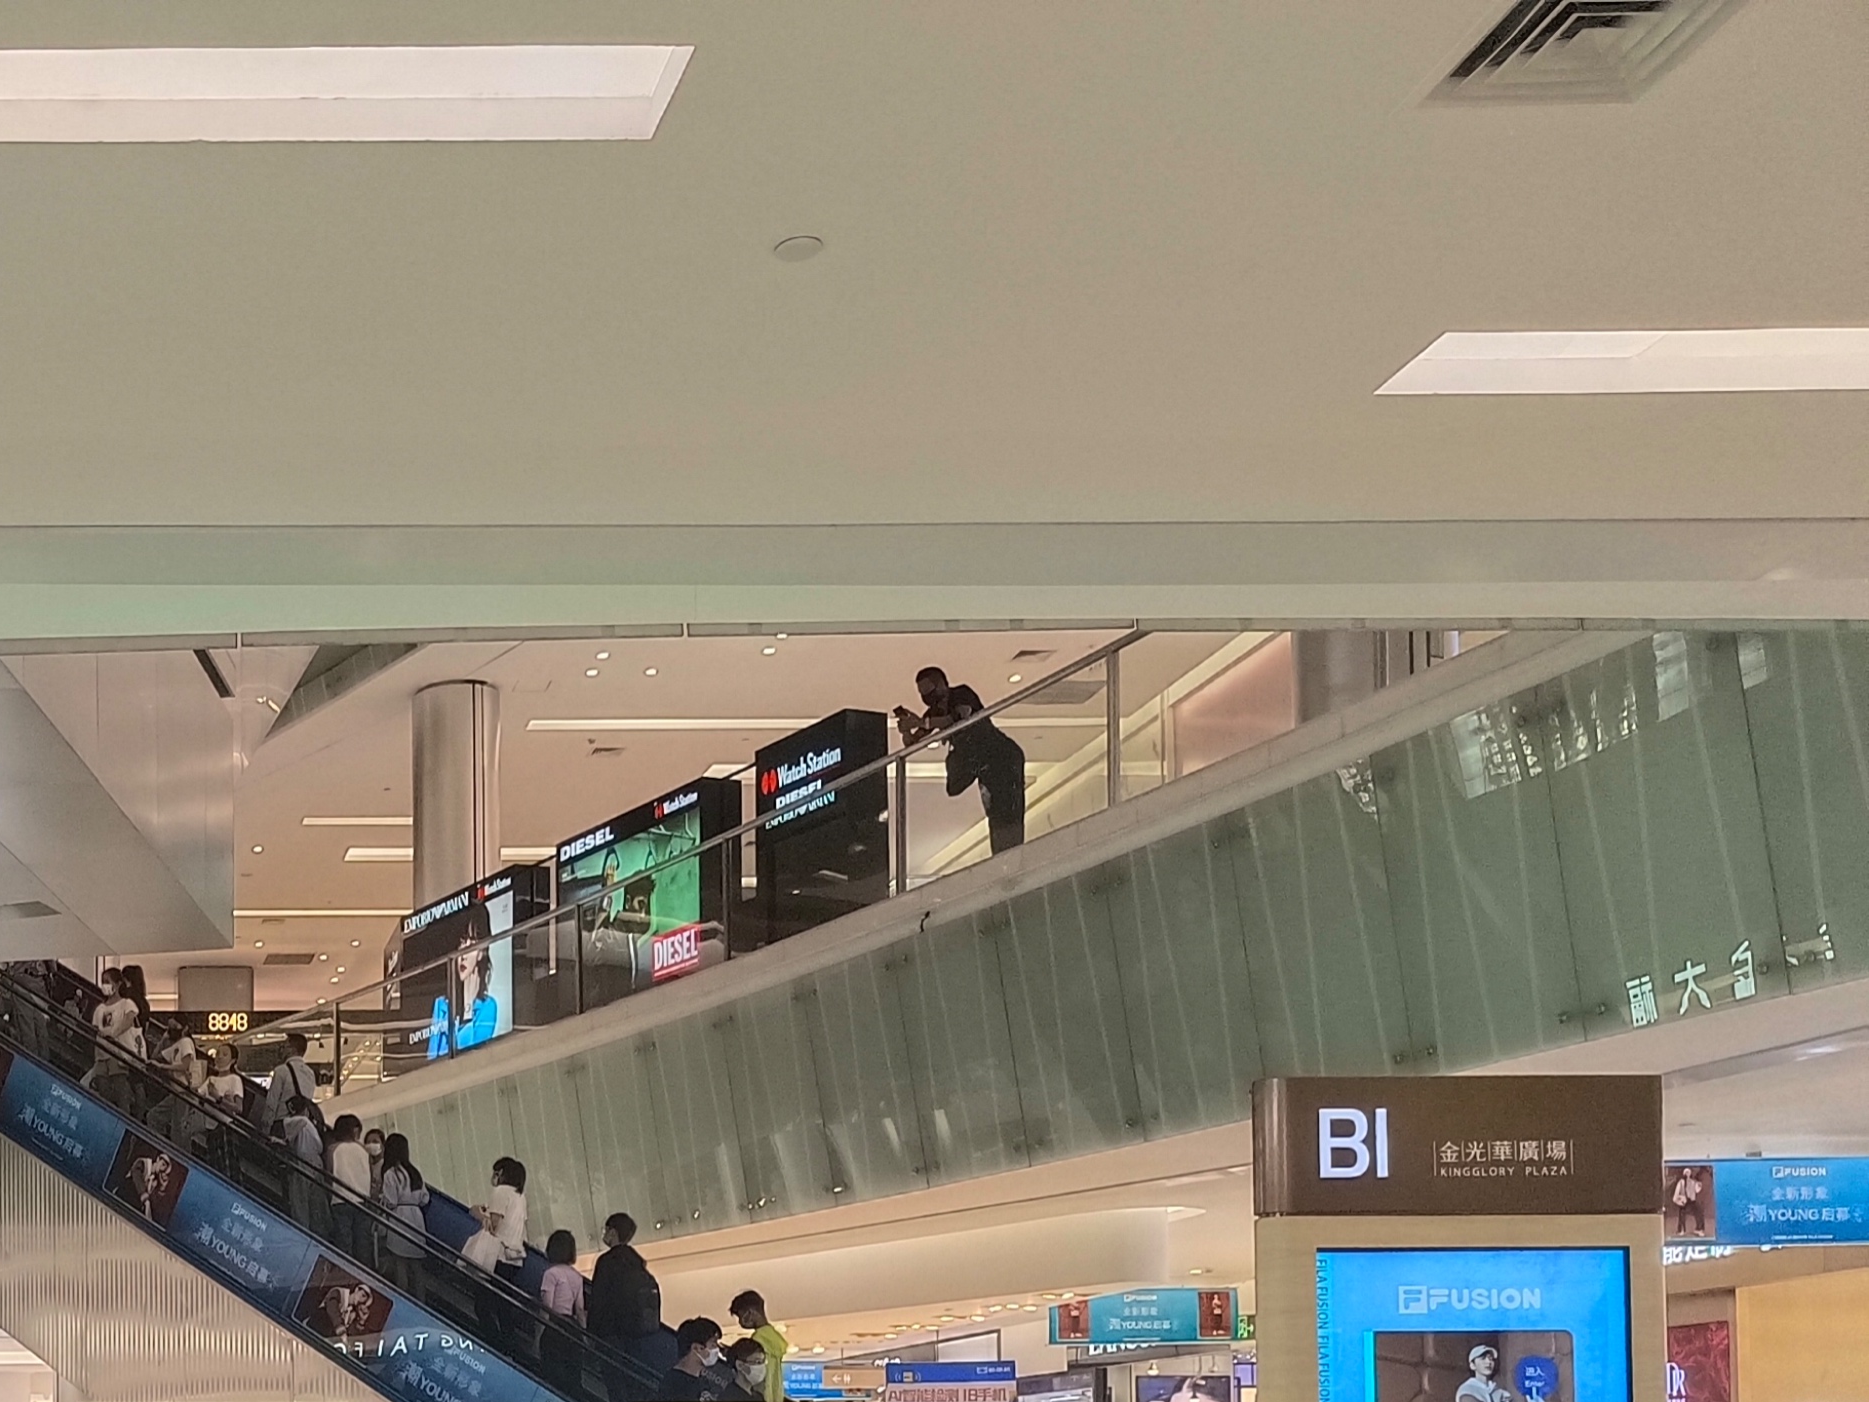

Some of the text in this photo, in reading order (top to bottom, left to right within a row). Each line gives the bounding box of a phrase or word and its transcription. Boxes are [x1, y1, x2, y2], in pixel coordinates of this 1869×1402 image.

[777, 747, 842, 789] Watch Station
[560, 826, 614, 862] DIESEL
[654, 928, 699, 970] DIESEL
[209, 1013, 248, 1032] 8848
[1438, 1140, 1568, 1162] 金光華廣場
[1440, 1165, 1568, 1177] KINGGLORY PLAZA
